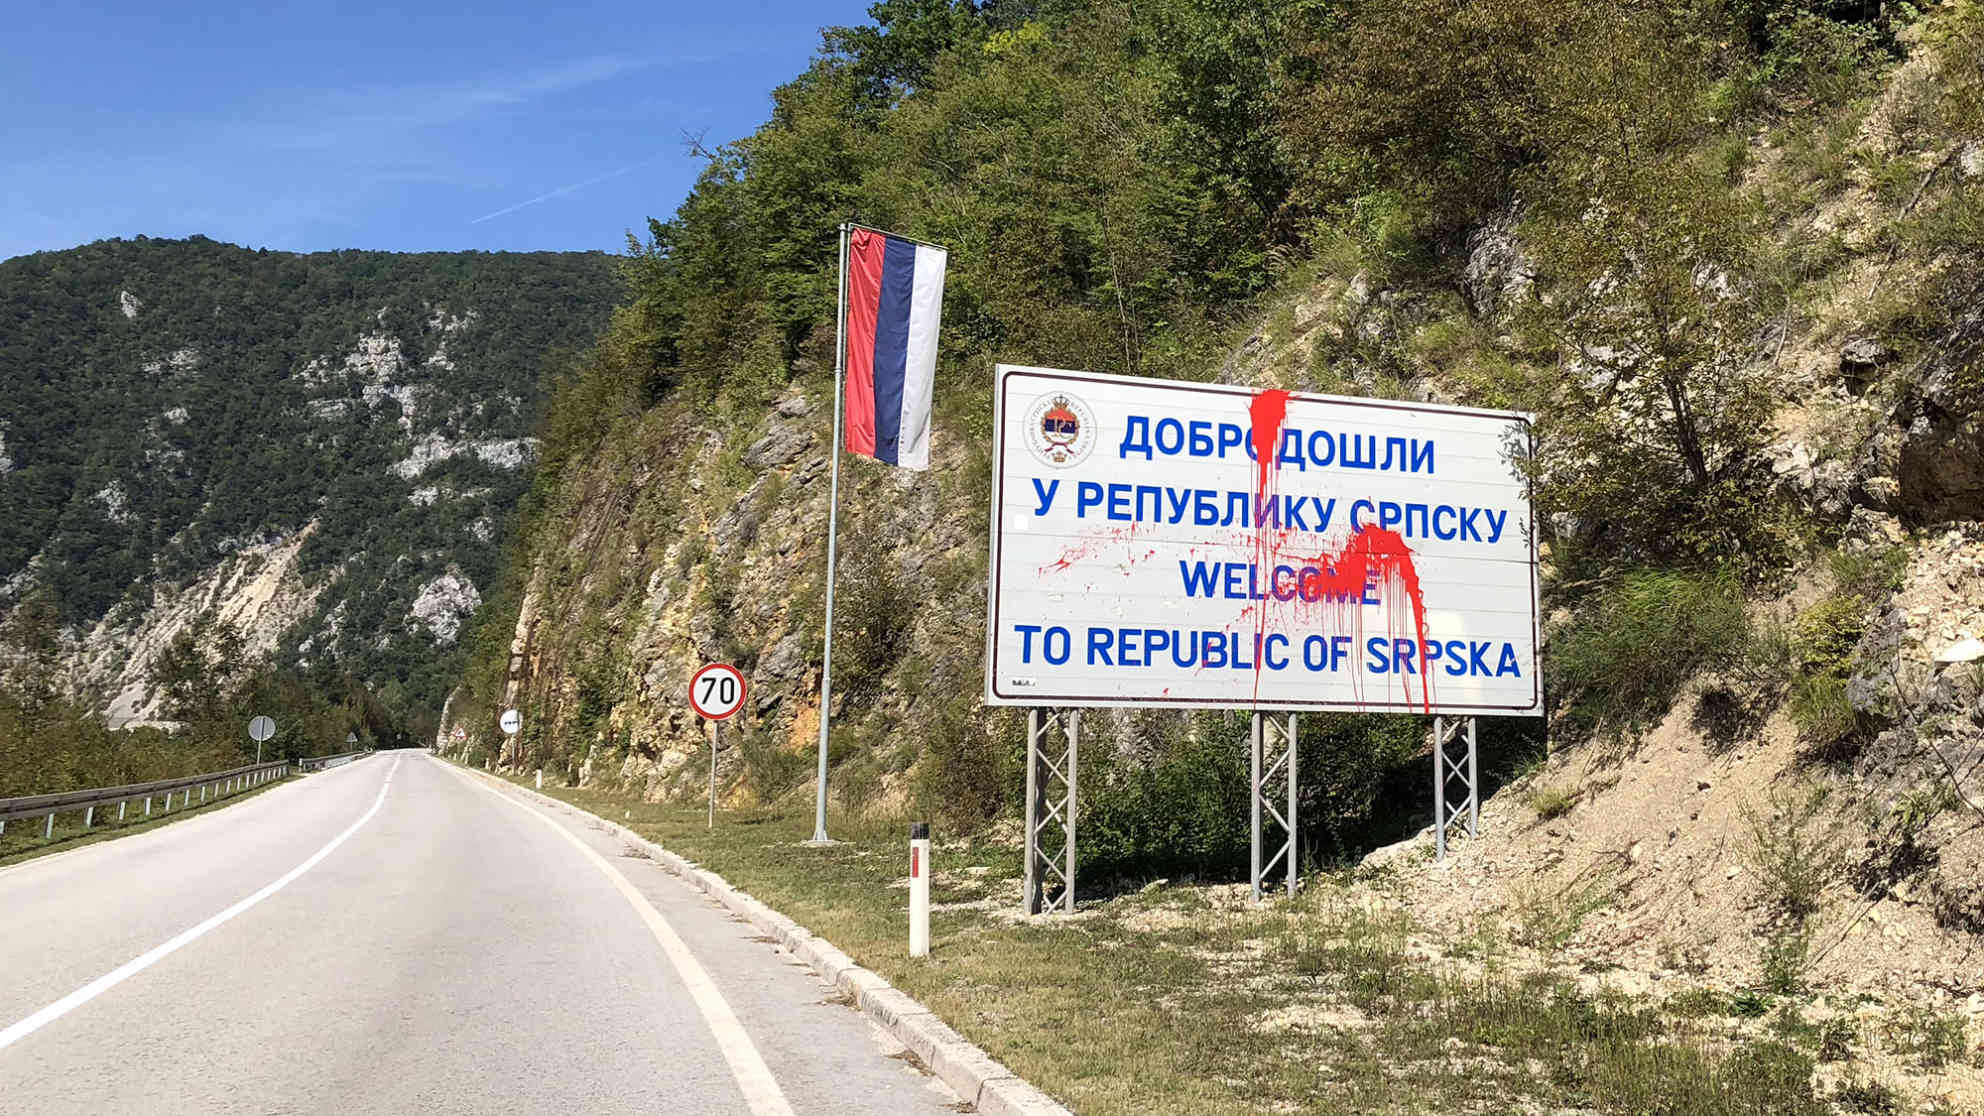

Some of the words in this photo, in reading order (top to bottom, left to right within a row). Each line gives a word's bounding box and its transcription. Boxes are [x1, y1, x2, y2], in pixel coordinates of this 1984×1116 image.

[1031, 478, 1060, 517] У
[1076, 481, 1337, 534] РЕПУБЛИКУ
[1350, 499, 1508, 544] СРПСКУ
[1179, 559, 1382, 605] WELCOE
[1013, 624, 1072, 667] TO
[1087, 627, 1290, 671] REPUBLIC
[1303, 635, 1352, 674] OF
[1366, 636, 1521, 678] SRPSKA
[702, 677, 735, 705] 70
